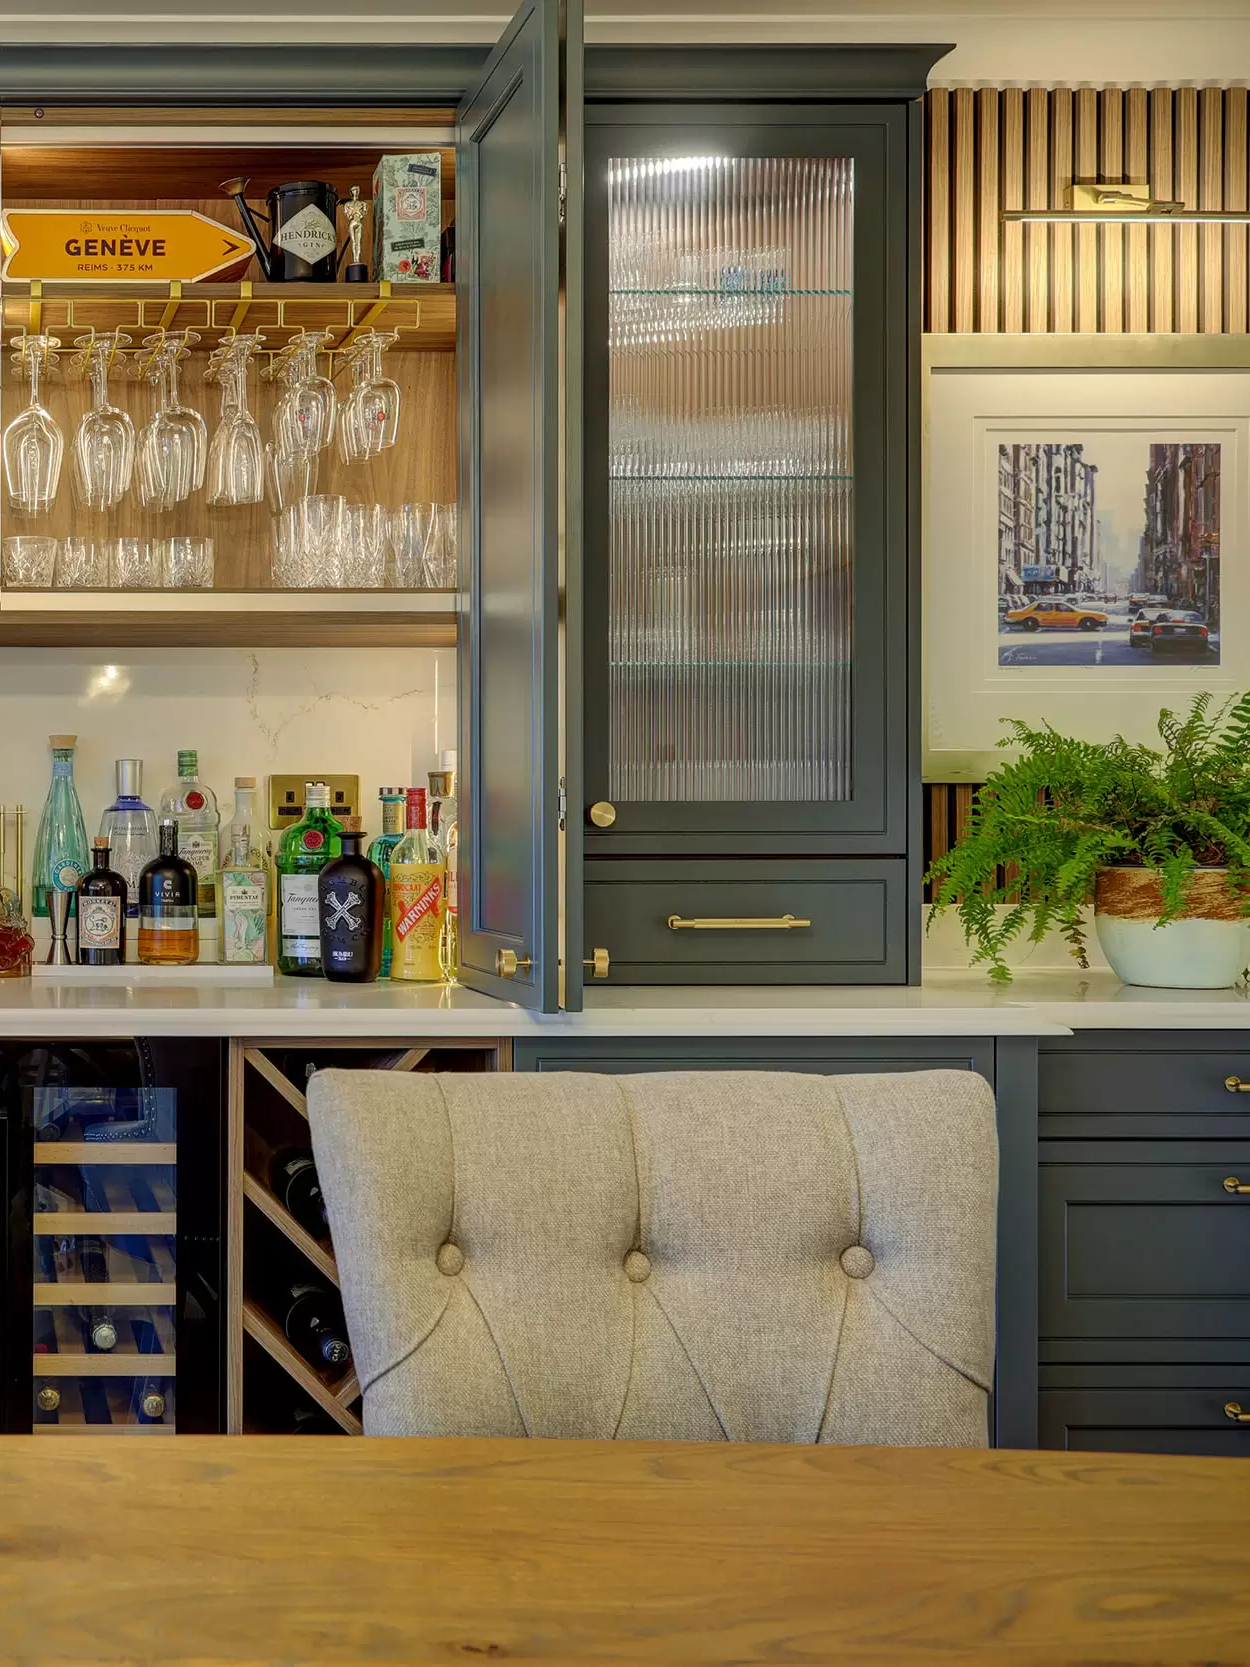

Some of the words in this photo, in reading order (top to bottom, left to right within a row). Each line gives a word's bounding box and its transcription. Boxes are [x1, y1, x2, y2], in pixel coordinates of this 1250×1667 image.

[97, 223, 118, 232] Veuve
[120, 223, 151, 233] Clicquot
[65, 234, 166, 256] GENÈVE
[179, 847, 212, 856] Tanqueray
[287, 893, 319, 905] Tanquer
[398, 882, 441, 935] WARNINKS
